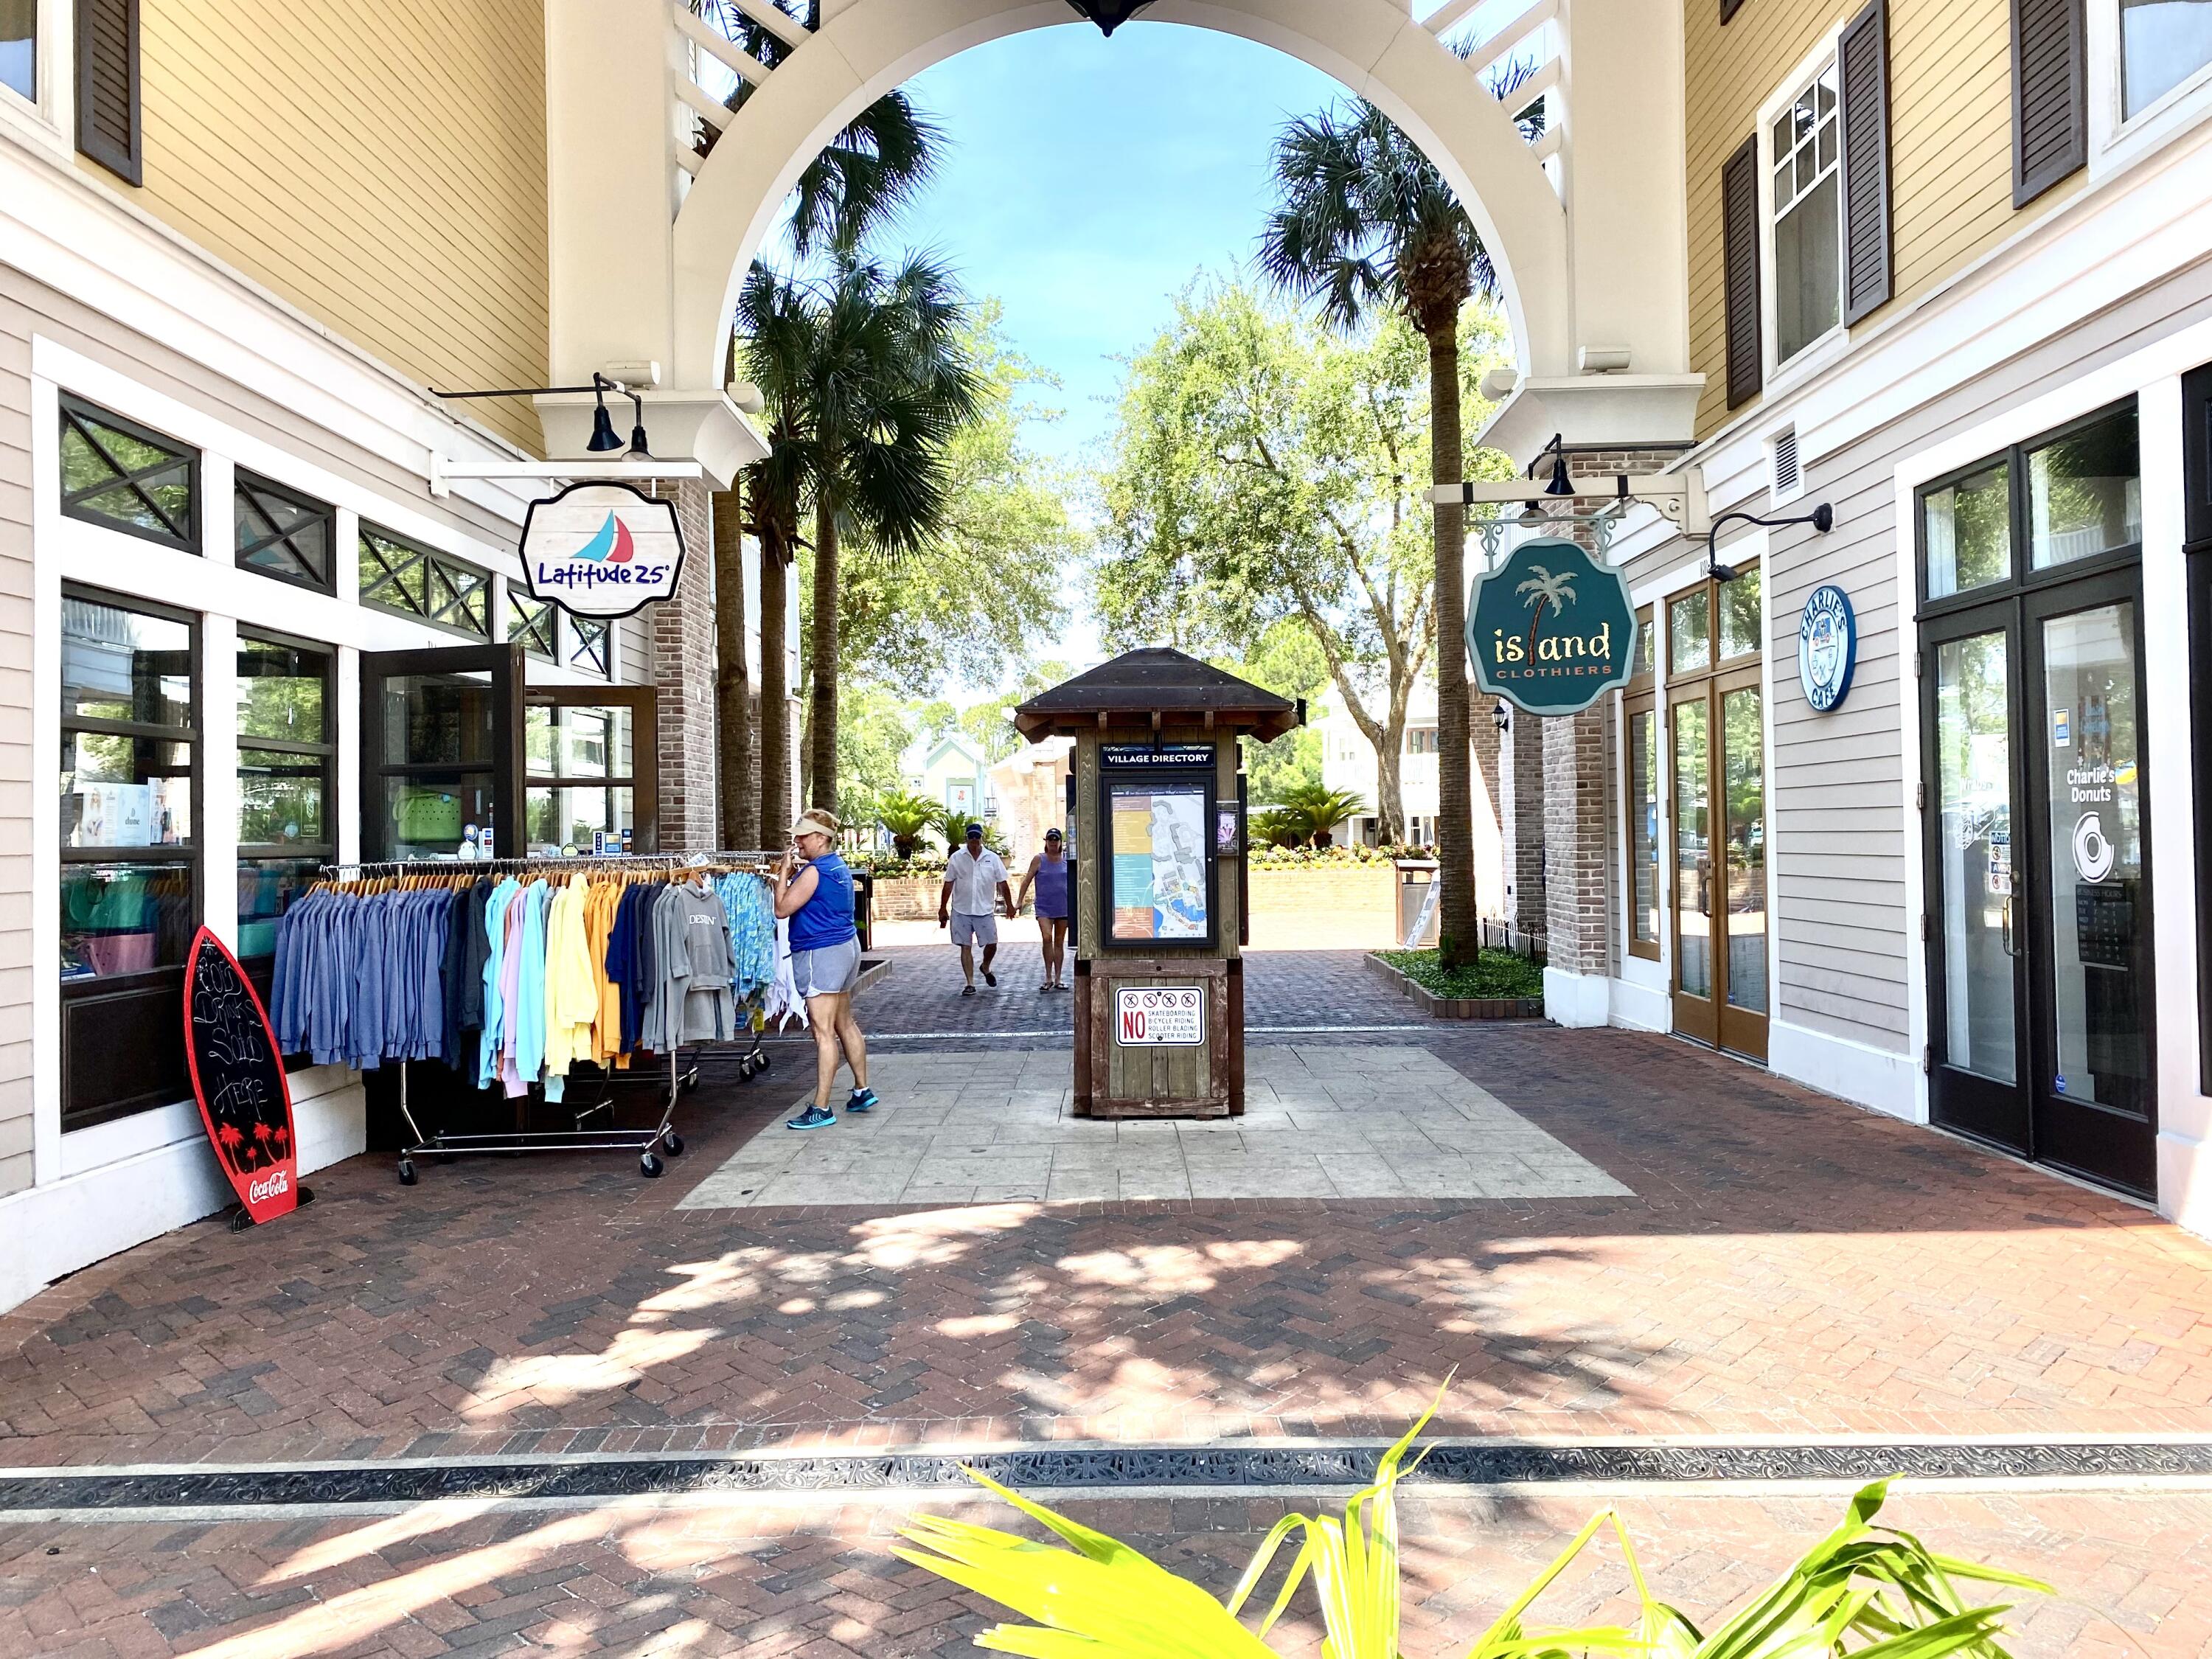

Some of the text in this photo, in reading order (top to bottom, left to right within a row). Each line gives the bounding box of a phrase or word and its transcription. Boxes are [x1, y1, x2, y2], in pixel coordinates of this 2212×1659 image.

[538, 562, 669, 590] Latitude 25°
[1801, 591, 1846, 641] CHARLIE'S
[1494, 622, 1610, 666] island
[1496, 665, 1612, 679] CLOTHIERS
[1107, 754, 1208, 763] VILLAGE DIRECTORY
[2067, 767, 2115, 785] Charlie's
[2071, 786, 2111, 803] Donuts
[689, 914, 716, 925] DESTIN
[196, 957, 243, 995] COLD
[194, 992, 262, 1033] DRINKS
[1124, 1011, 1145, 1039] NO
[209, 1023, 263, 1065] SOLD
[214, 1074, 268, 1120] HERE
